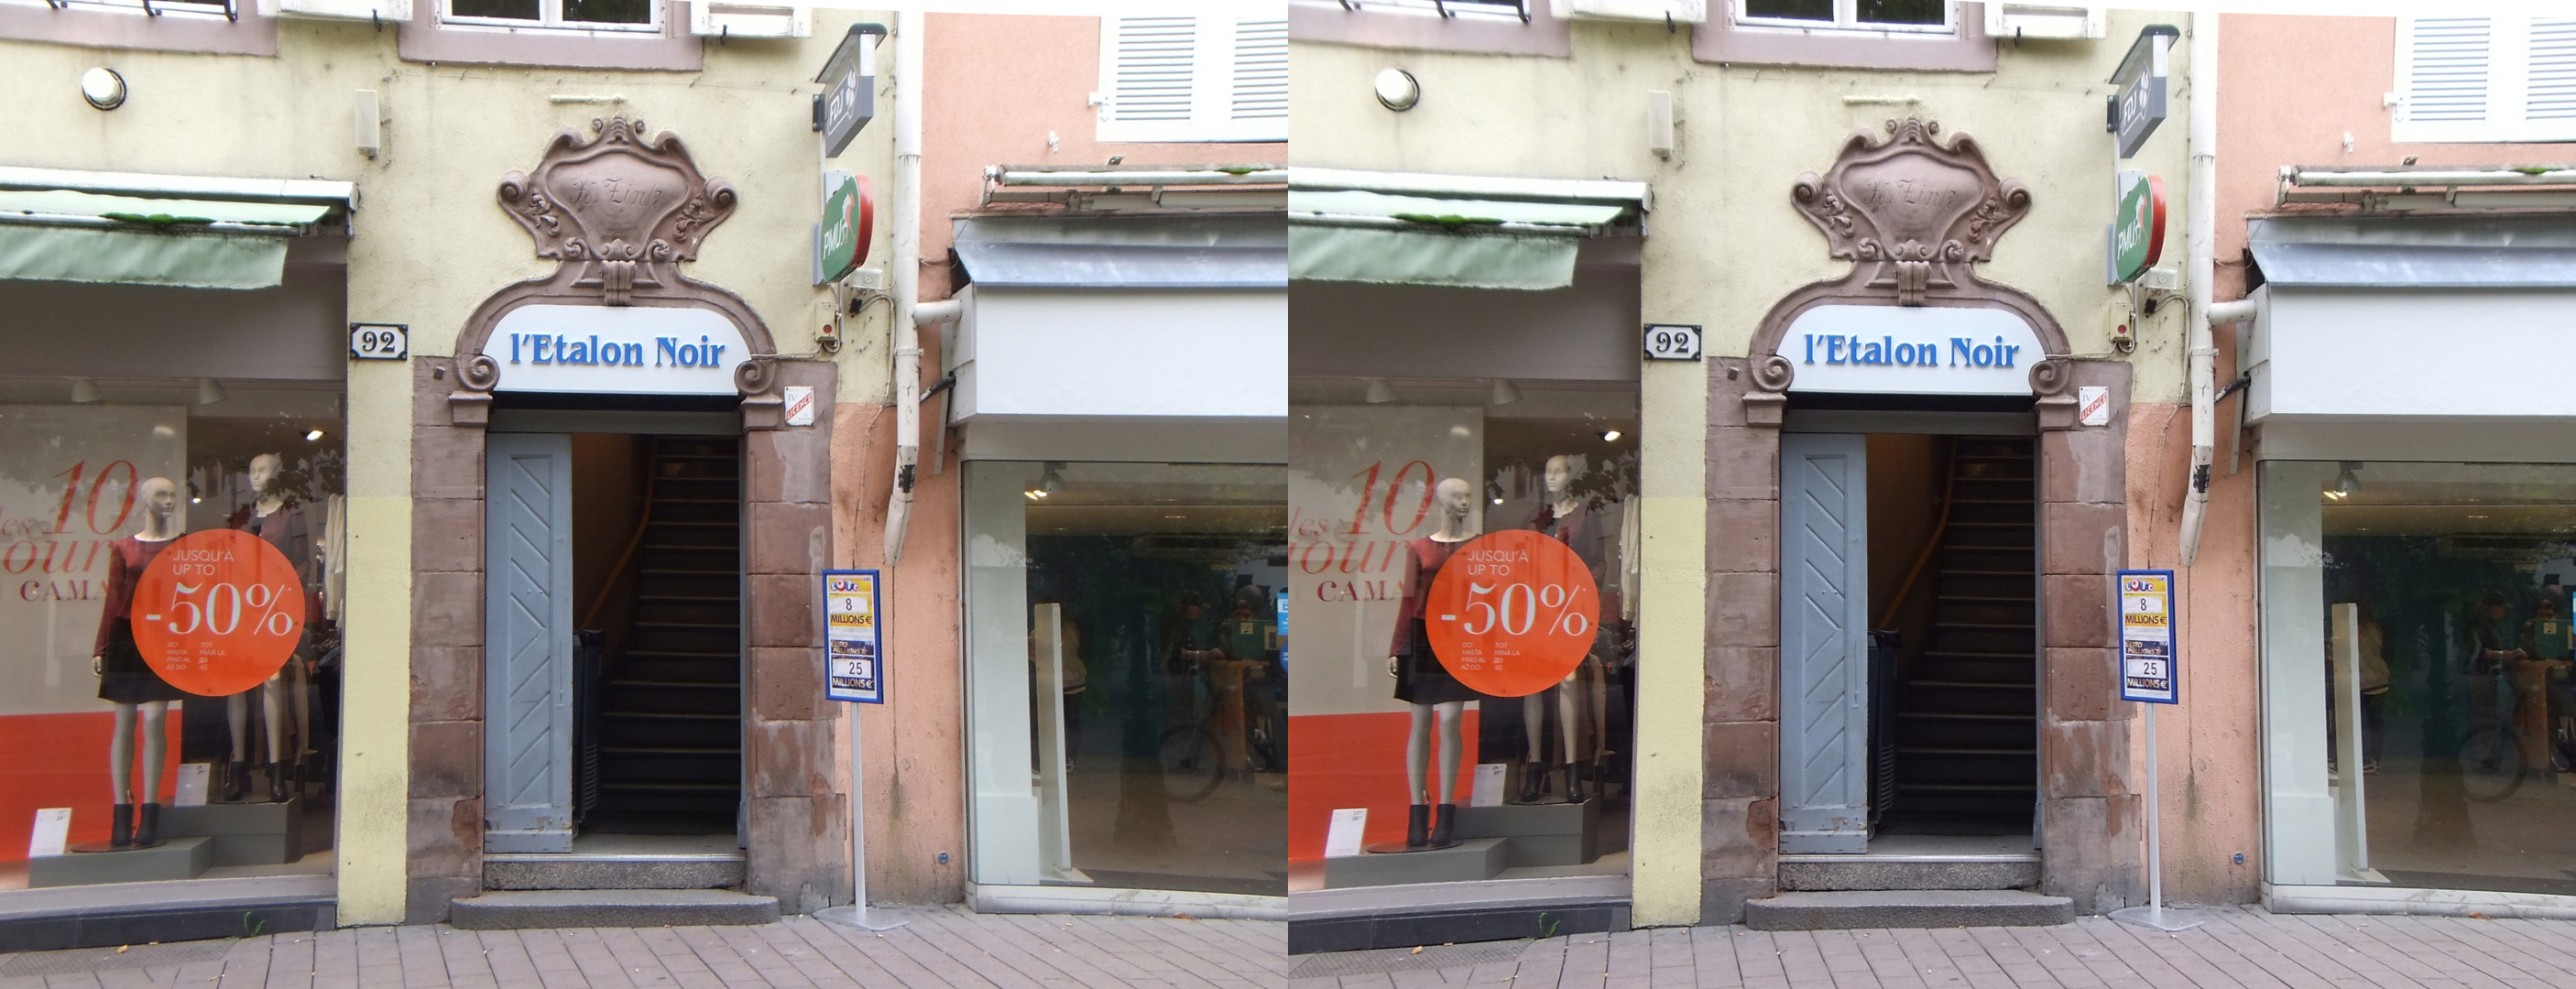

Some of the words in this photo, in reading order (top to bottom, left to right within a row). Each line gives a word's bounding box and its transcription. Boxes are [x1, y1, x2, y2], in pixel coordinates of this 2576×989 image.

[830, 88, 844, 125] FDJ
[2123, 89, 2137, 126] FDJ
[823, 218, 844, 261] PMU
[2117, 218, 2138, 261] PMU
[362, 331, 396, 353] 92
[510, 332, 644, 366] l'Etalon
[656, 334, 726, 367] Noir
[1656, 331, 1689, 353] 92
[1805, 333, 1937, 366] l'Etalon
[1949, 335, 2020, 367] Noir
[787, 394, 813, 420] LICENCE
[2081, 394, 2107, 420] LICENCE
[0, 506, 33, 536] es
[42, 460, 137, 535] 10
[1339, 460, 1435, 535] 10
[173, 549, 235, 562] JUSQU'À
[1468, 549, 1529, 562] JUSQU'À
[173, 564, 191, 575] UP
[195, 564, 215, 576] TO
[1468, 564, 1486, 576] UP
[1490, 564, 1510, 576] TO
[831, 578, 859, 592] LOTO
[2125, 578, 2154, 592] LOTO
[147, 581, 293, 636] -50%
[846, 598, 852, 611] 8
[1441, 581, 1588, 636] -50%
[2140, 598, 2146, 611] 8
[831, 614, 864, 624] MILLIONS
[2125, 615, 2158, 625] MILLIONS
[849, 662, 863, 675] 25
[2144, 662, 2156, 675] 25
[833, 678, 866, 688] MILLIONS
[2127, 678, 2159, 688] MILLIONS
